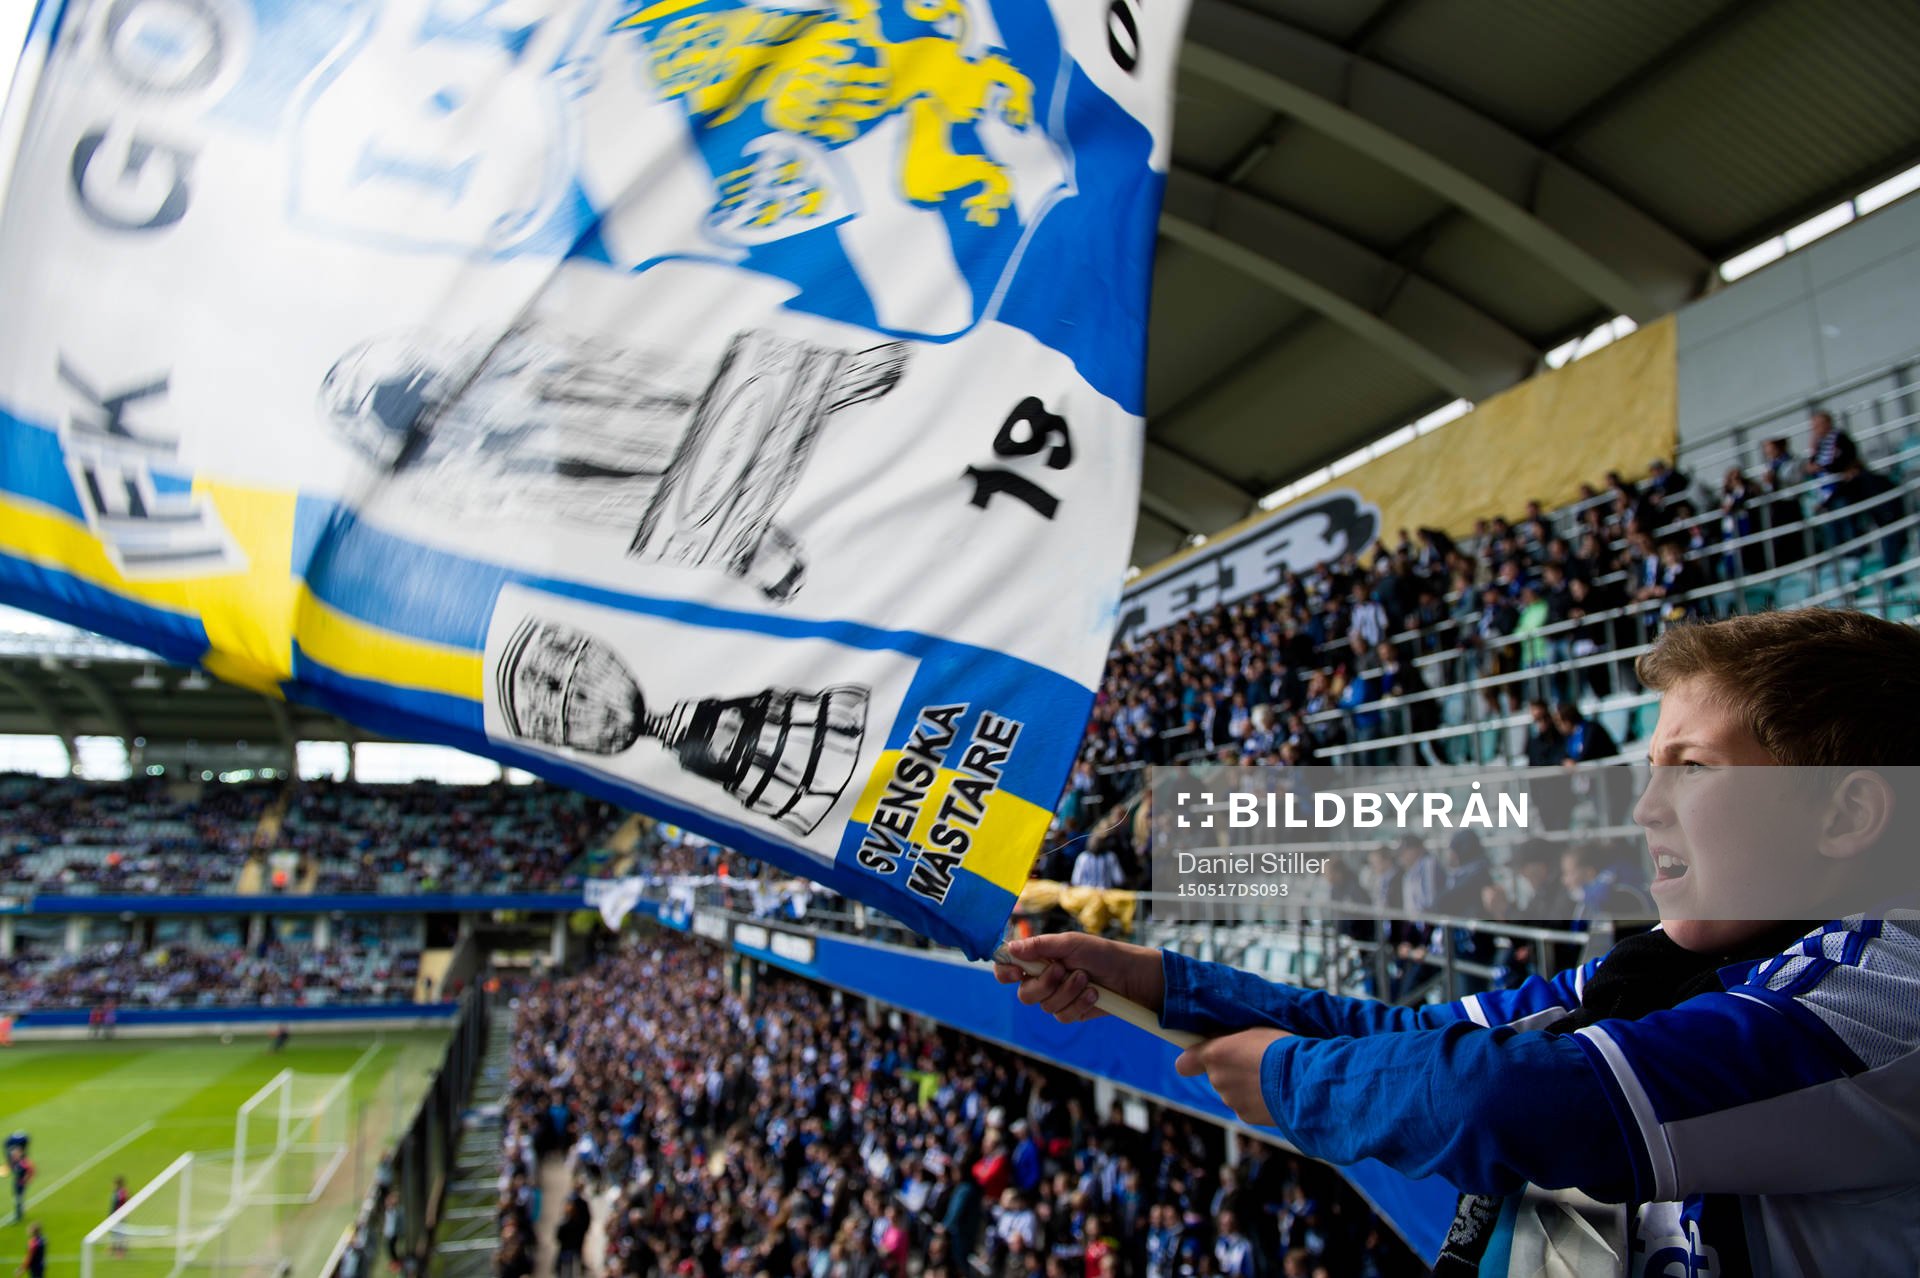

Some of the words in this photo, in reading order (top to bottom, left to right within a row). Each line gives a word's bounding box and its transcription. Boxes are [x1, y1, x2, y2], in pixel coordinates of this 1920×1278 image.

[55, 350, 226, 568] IFK
[960, 396, 1073, 520] 19
[858, 703, 970, 874] SVENSKA
[906, 711, 1023, 904] MÄSTARE
